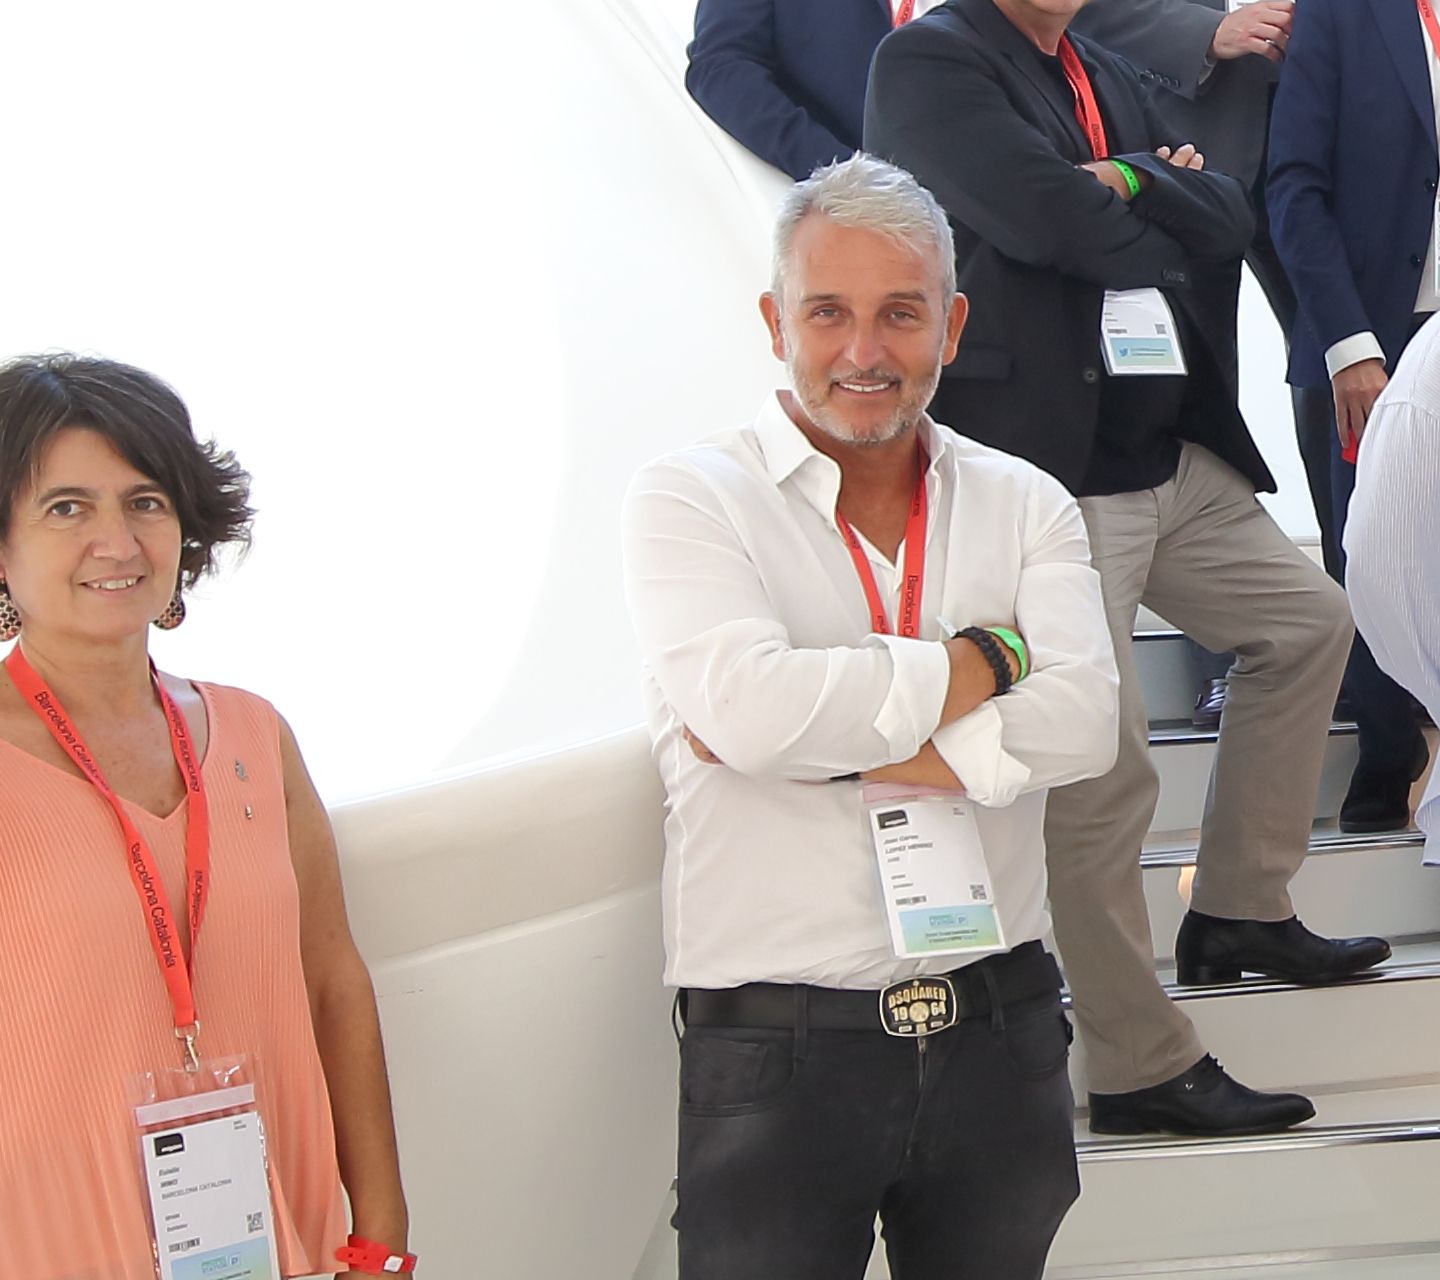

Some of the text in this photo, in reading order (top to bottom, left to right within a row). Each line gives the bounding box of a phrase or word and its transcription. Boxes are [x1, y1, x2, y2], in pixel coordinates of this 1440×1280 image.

[903, 575, 919, 624] Barcelona
[34, 690, 110, 792] Barcelona Catalonia
[131, 842, 178, 969] Barcelona Catalonia
[887, 986, 947, 1009] DSQUARED
[891, 1001, 947, 1022] 19 64
[161, 1179, 232, 1200] BARCELONA CATALONIA
